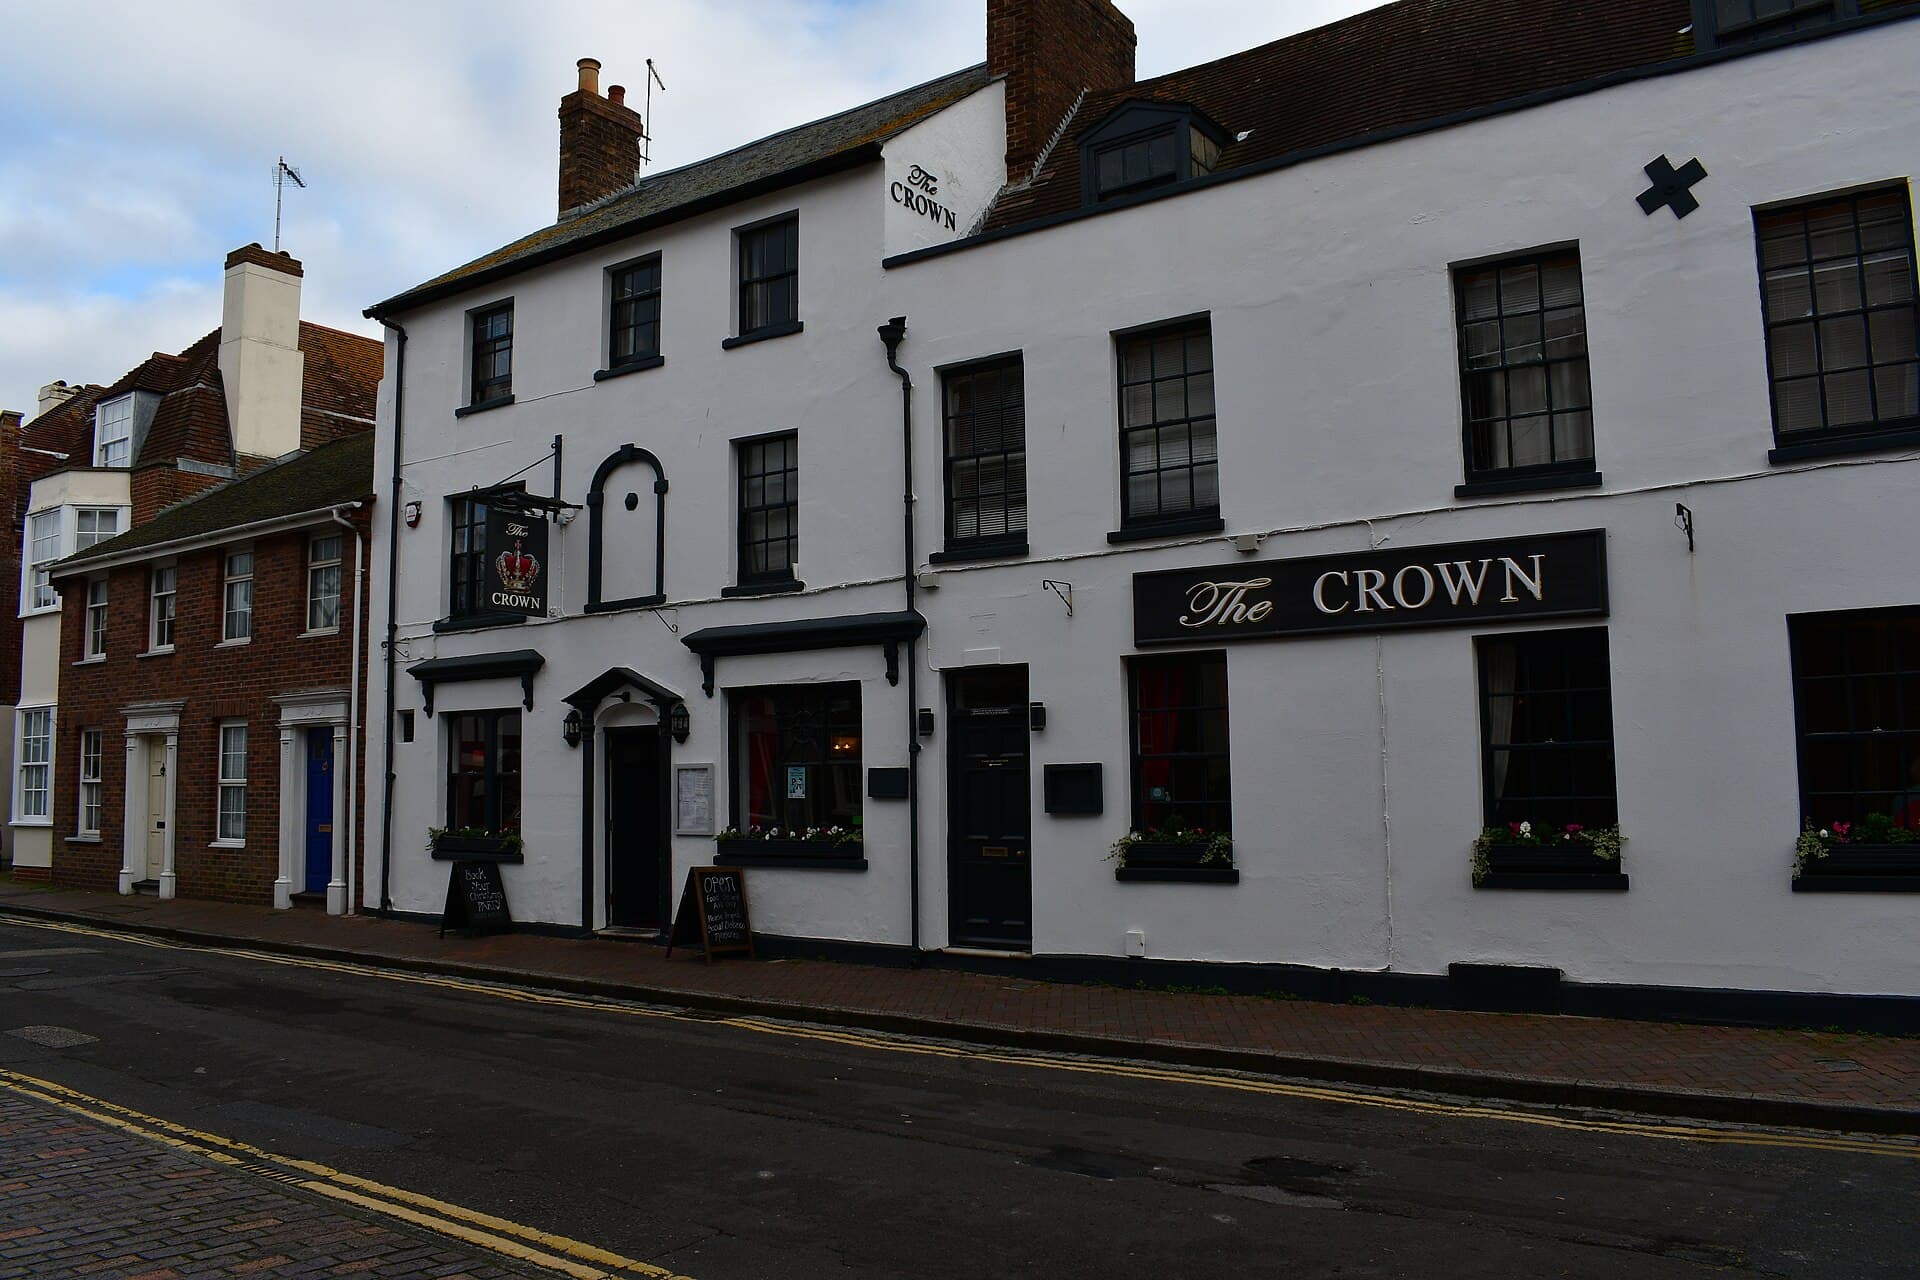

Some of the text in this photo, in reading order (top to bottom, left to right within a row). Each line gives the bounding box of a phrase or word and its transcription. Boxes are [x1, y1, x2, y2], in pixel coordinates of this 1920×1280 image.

[907, 164, 938, 195] The
[890, 181, 956, 231] CROWN
[505, 522, 529, 538] The
[491, 592, 541, 609] CROWN
[1178, 553, 1545, 627] The CROWN
